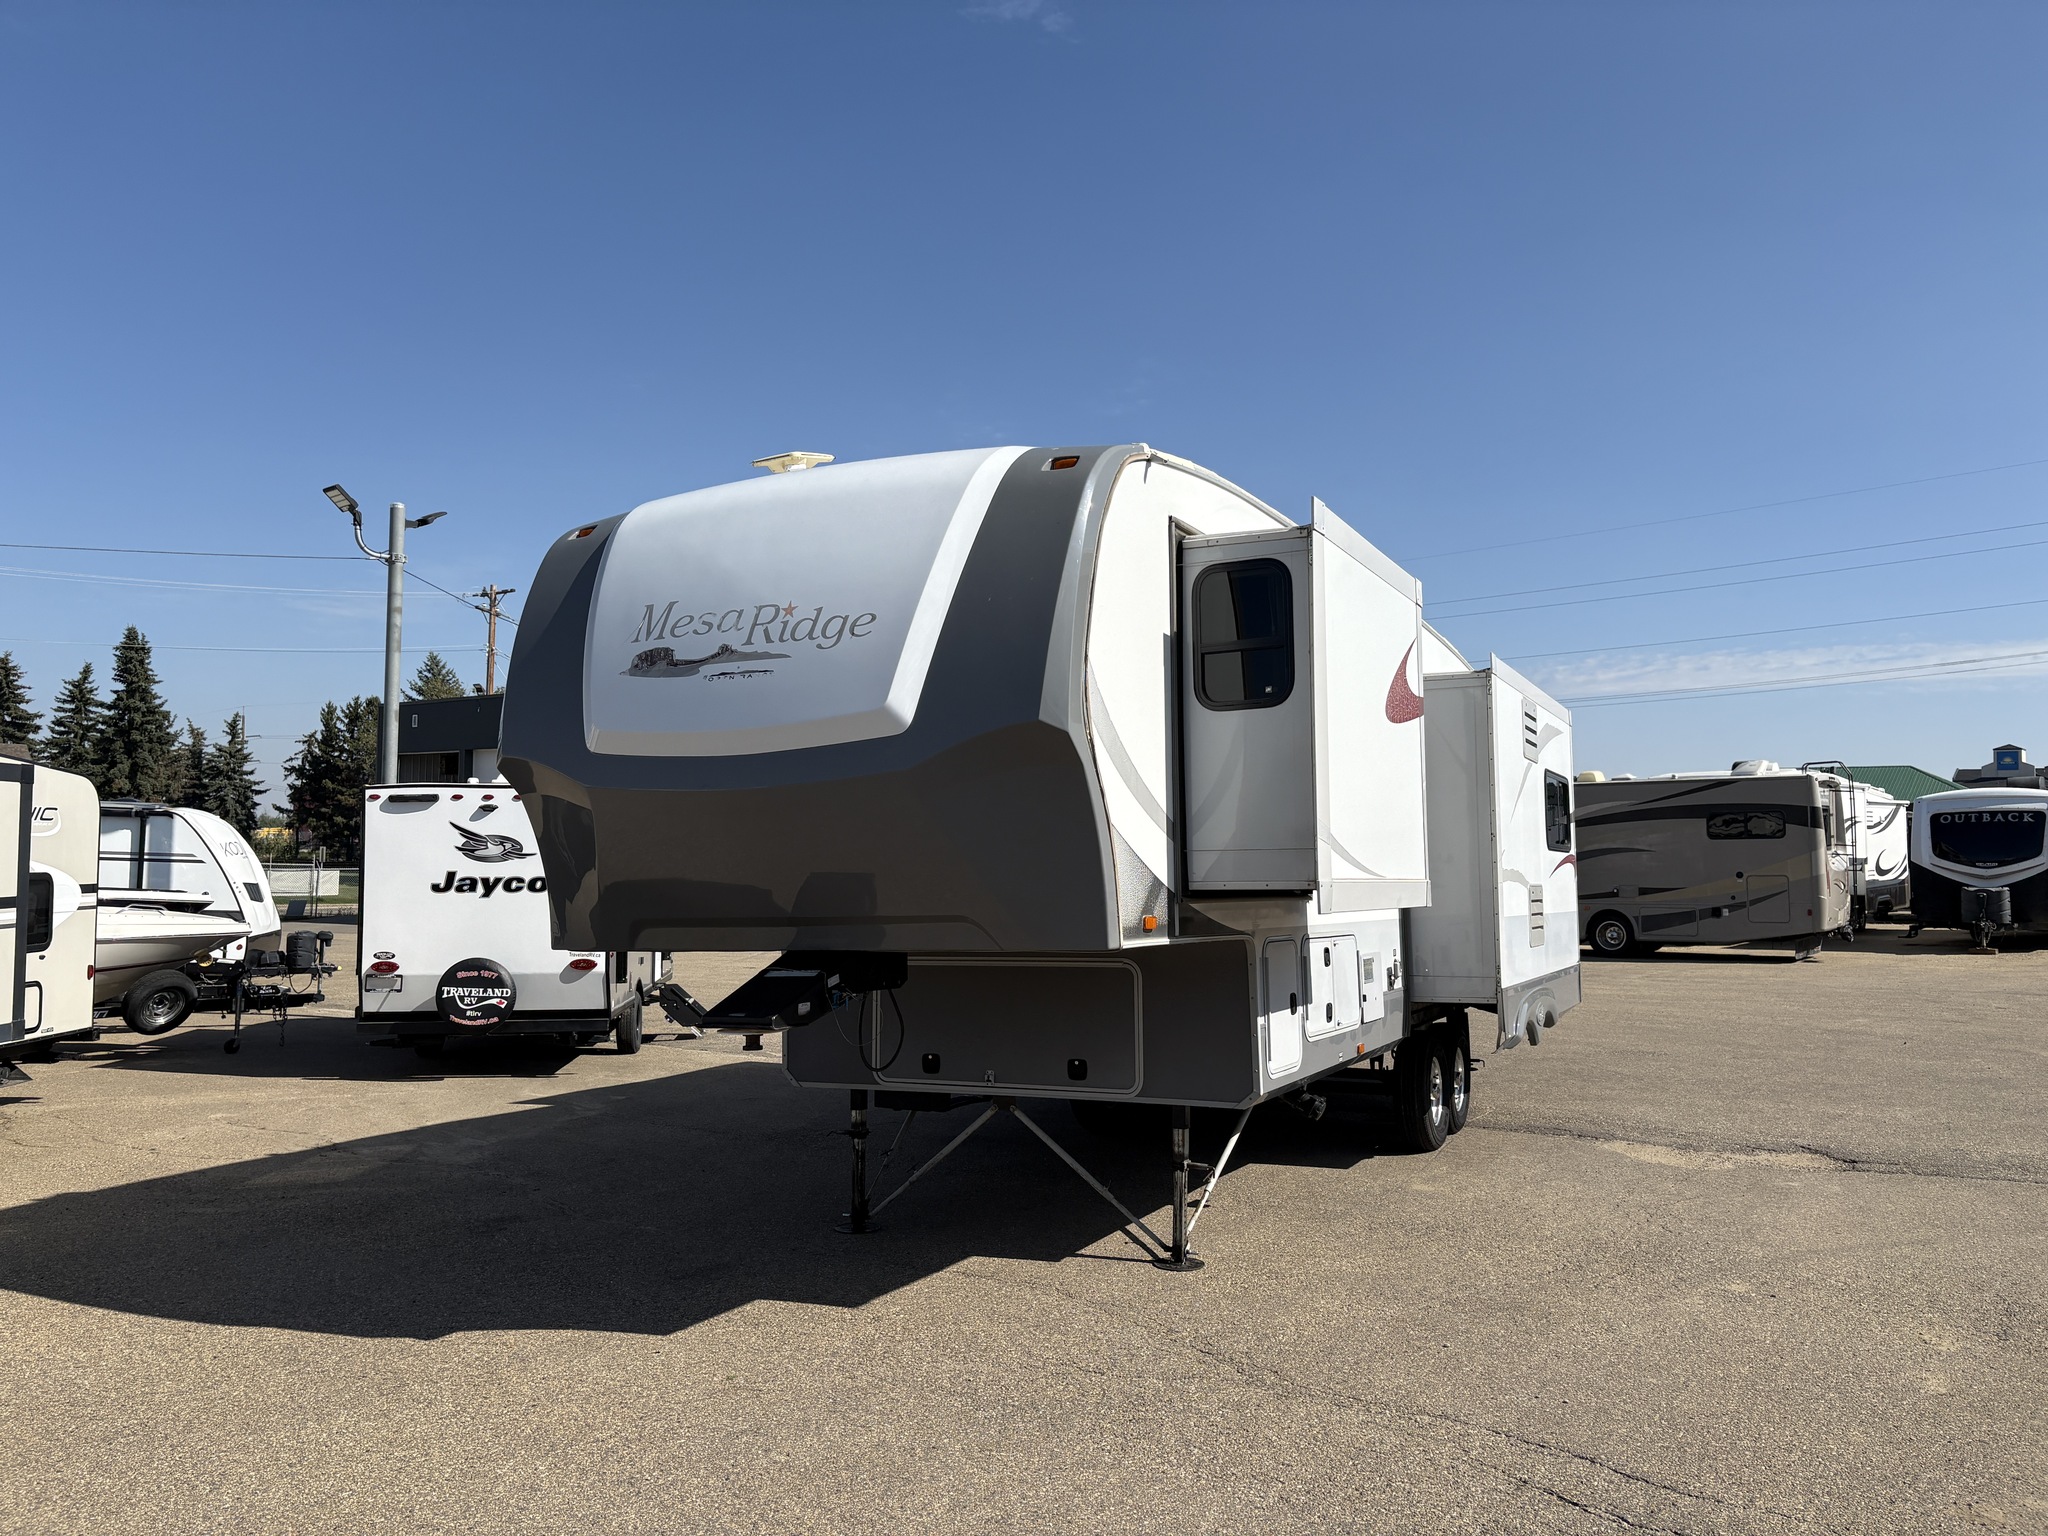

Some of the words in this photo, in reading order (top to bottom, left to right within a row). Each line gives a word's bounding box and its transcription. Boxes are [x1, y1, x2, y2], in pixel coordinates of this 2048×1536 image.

[630, 600, 744, 644] Mesa
[741, 600, 877, 650] Ridge
[1940, 812, 2035, 824] OUTBACK
[430, 870, 547, 898] Jayco
[456, 970, 479, 979] Since
[480, 970, 499, 979] 1977
[441, 986, 511, 998] TRAVELAND
